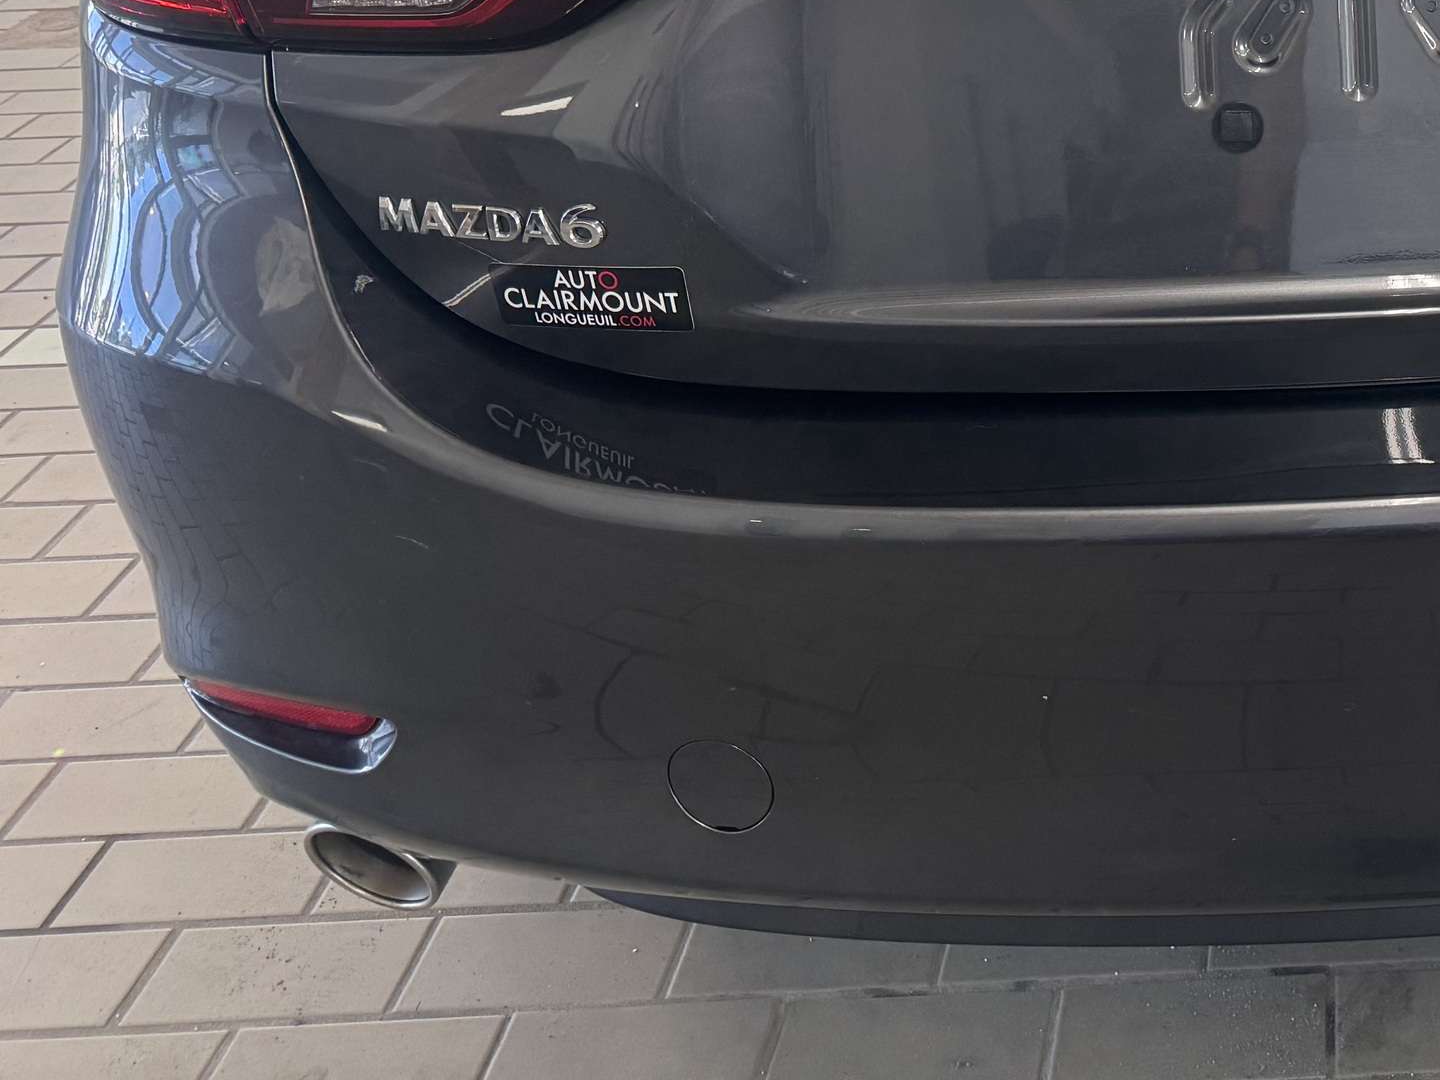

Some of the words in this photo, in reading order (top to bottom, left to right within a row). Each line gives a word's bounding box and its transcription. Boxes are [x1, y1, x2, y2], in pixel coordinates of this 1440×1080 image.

[378, 195, 605, 249] MAZDA6
[554, 270, 619, 290] AUTO
[503, 287, 679, 314] CLAIRMOUNT
[534, 311, 656, 327] LONGUEUIL.COM
